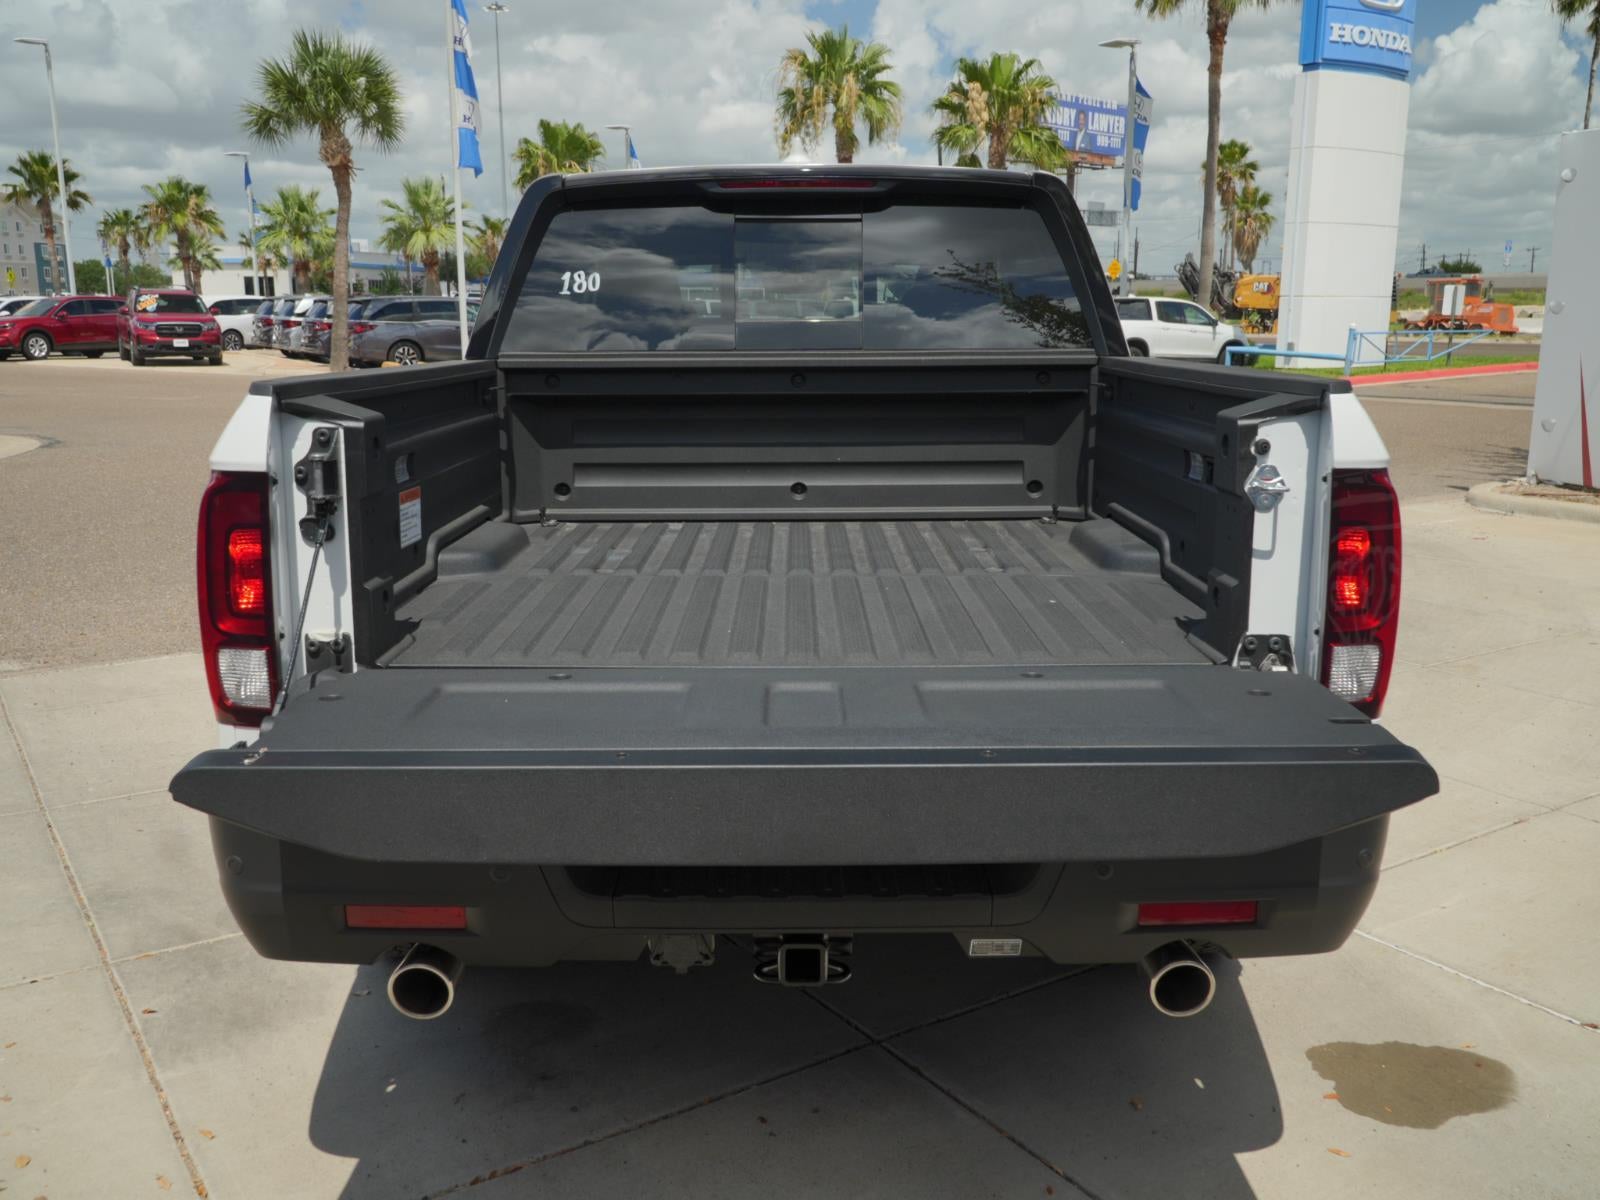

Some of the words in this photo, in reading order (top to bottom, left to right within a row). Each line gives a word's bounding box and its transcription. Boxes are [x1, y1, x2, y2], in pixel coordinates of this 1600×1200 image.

[1328, 22, 1413, 55] HONDA
[1040, 106, 1077, 127] NJURY
[1088, 111, 1126, 135] LAWYER
[558, 270, 601, 295] 180
[1253, 281, 1269, 293] CAT
